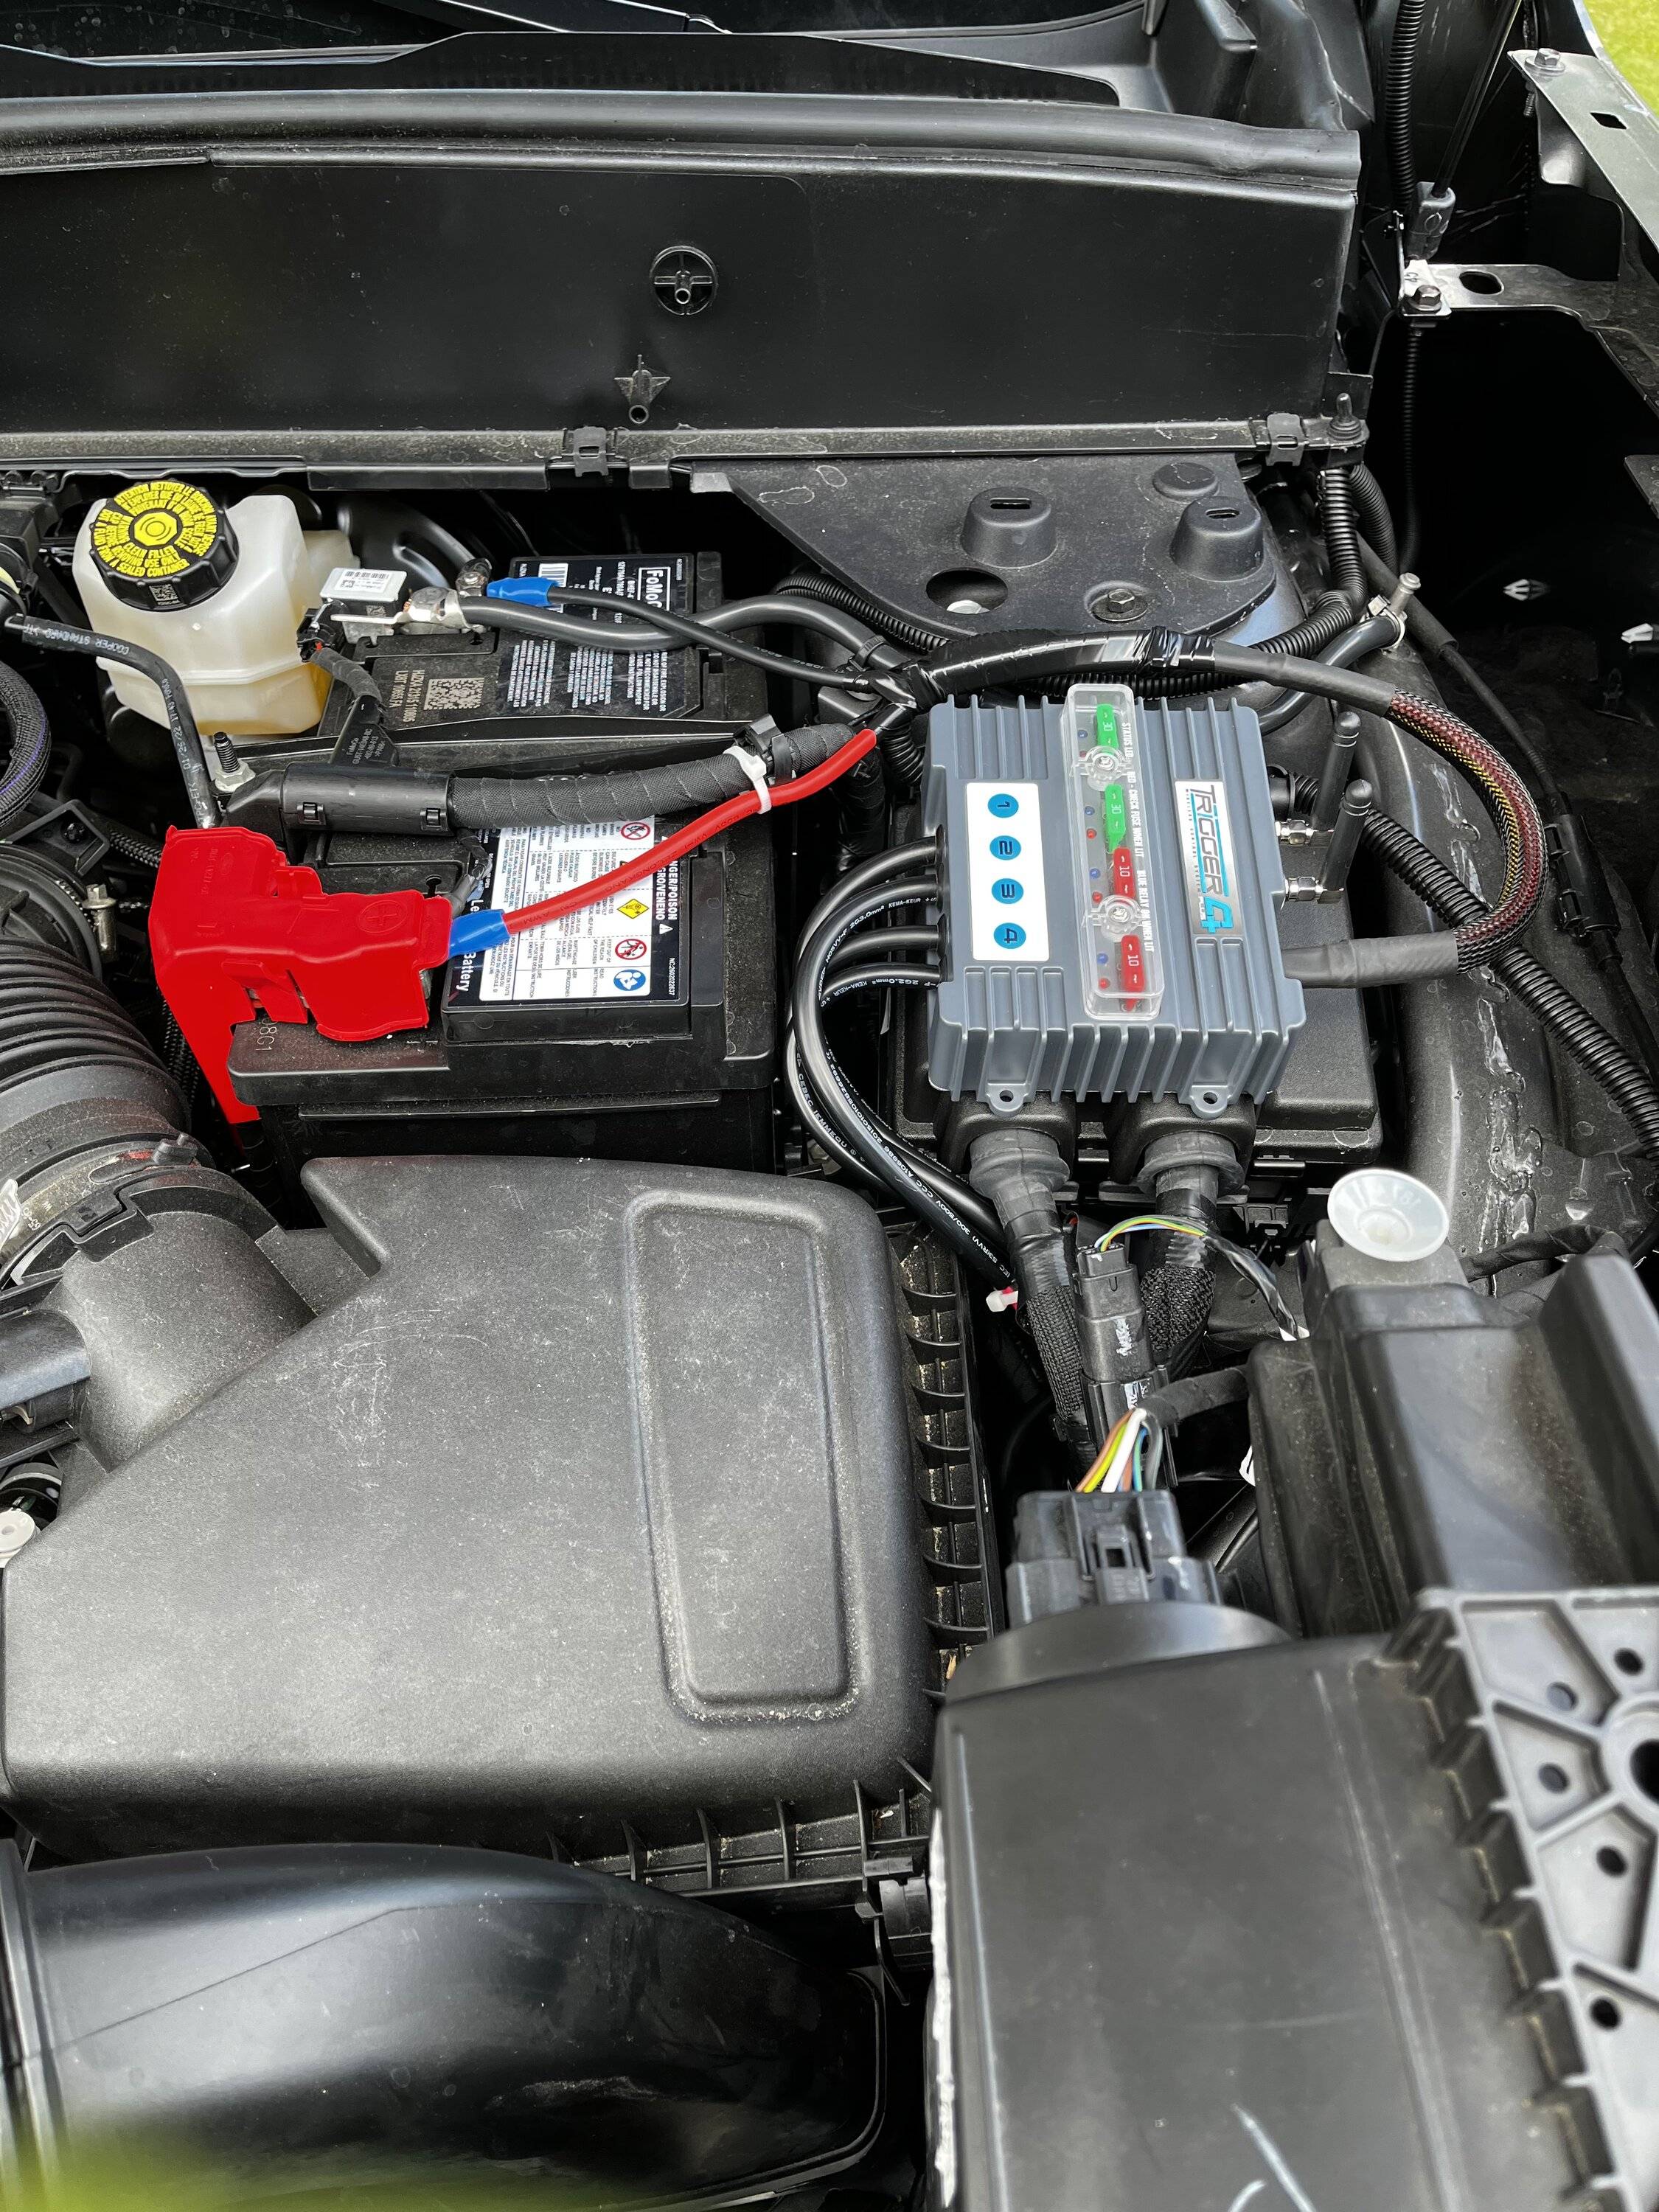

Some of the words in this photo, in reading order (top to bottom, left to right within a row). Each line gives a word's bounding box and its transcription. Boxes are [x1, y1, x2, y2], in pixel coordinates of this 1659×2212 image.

[113, 483, 149, 505] ATTENTION
[149, 481, 185, 493] NETTOYER
[181, 486, 195, 496] LE
[189, 490, 215, 515] BOUCHON
[204, 513, 217, 533] AVANT
[94, 527, 107, 546] FLUID
[192, 520, 205, 537] FREIN
[96, 543, 116, 562] FROM
[122, 541, 146, 558] CLEAN
[109, 557, 121, 567] A
[142, 558, 160, 568] USE
[160, 552, 182, 566] ONLY
[145, 557, 190, 577] CONTAINER
[115, 561, 146, 577] SEALED
[645, 569, 664, 608] FoMoC
[44, 628, 90, 644] STANDARD
[95, 638, 130, 655] COOPER
[627, 667, 635, 698] INSTRUCTIONS
[643, 667, 651, 700] RECOMMENDED
[1103, 722, 1113, 731] 30
[1121, 722, 1133, 746] STATUS
[1127, 771, 1136, 783] RED
[1128, 789, 1139, 810] CHECK
[1111, 804, 1121, 814] 30
[1130, 810, 1141, 827] FUSE
[1133, 827, 1143, 846] WHEN
[999, 840, 1013, 855] 2
[1135, 848, 1144, 858] LIT
[1119, 866, 1130, 877] 10
[1136, 870, 1147, 886] BLUE
[655, 867, 666, 920] GRO/VENENO
[667, 860, 678, 920] NGER/POISON
[1001, 883, 1015, 899] 3
[1138, 887, 1149, 908] RELAY
[888, 897, 921, 908] KEMA-KEUR
[1198, 896, 1206, 922] PLUS
[1141, 909, 1150, 919] ON
[1201, 897, 1234, 933] 4
[1003, 928, 1018, 944] 4
[1141, 920, 1152, 941] WHEN
[1144, 942, 1155, 952] LIT
[1127, 954, 1139, 967] 10
[456, 953, 476, 992] Battery
[832, 980, 868, 996] KEMA-KEUR
[798, 1073, 814, 1106] CEBEC
[916, 1179, 933, 1198] CCC
[936, 1199, 970, 1235] 300/500V
[999, 1264, 1010, 1278] IEC
